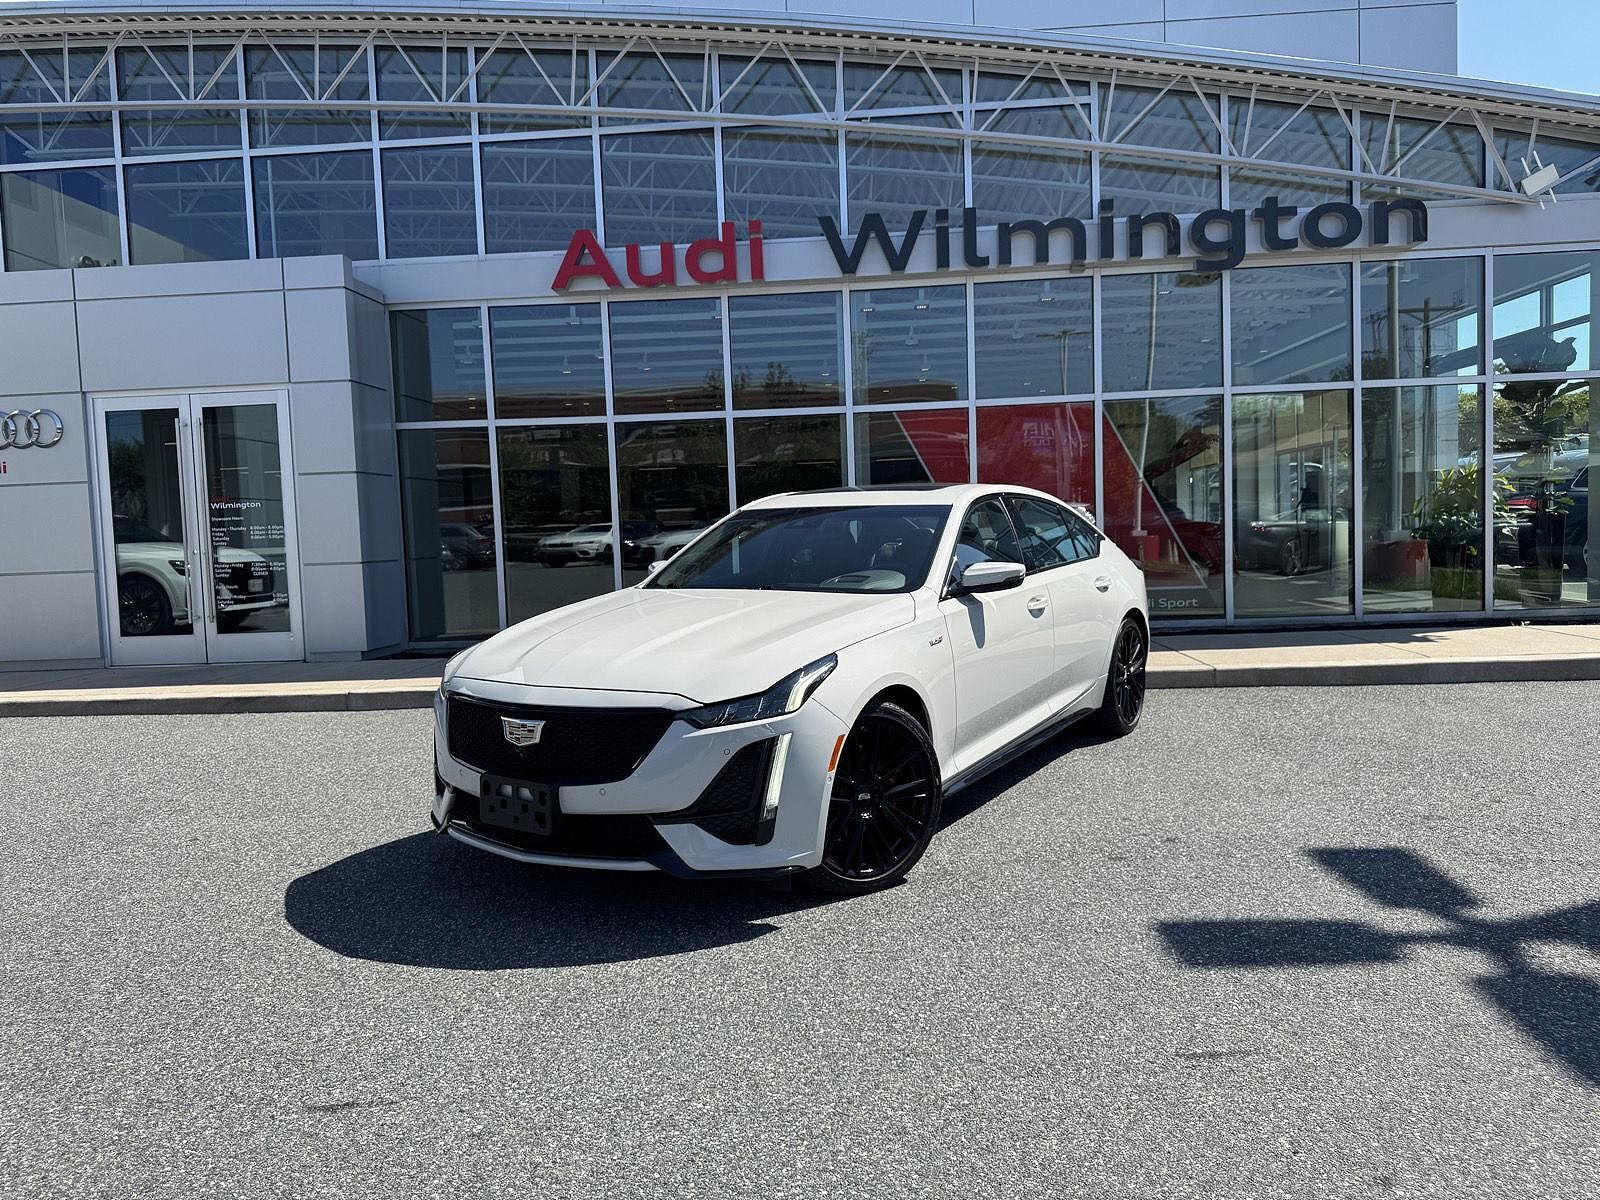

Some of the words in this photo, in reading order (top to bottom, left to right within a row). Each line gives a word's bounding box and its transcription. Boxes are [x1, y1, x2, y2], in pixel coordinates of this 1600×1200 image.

[551, 219, 764, 294] Audi
[817, 194, 1428, 274] Wilmington
[210, 501, 261, 510] Wilmington
[1159, 598, 1198, 609] Sport
